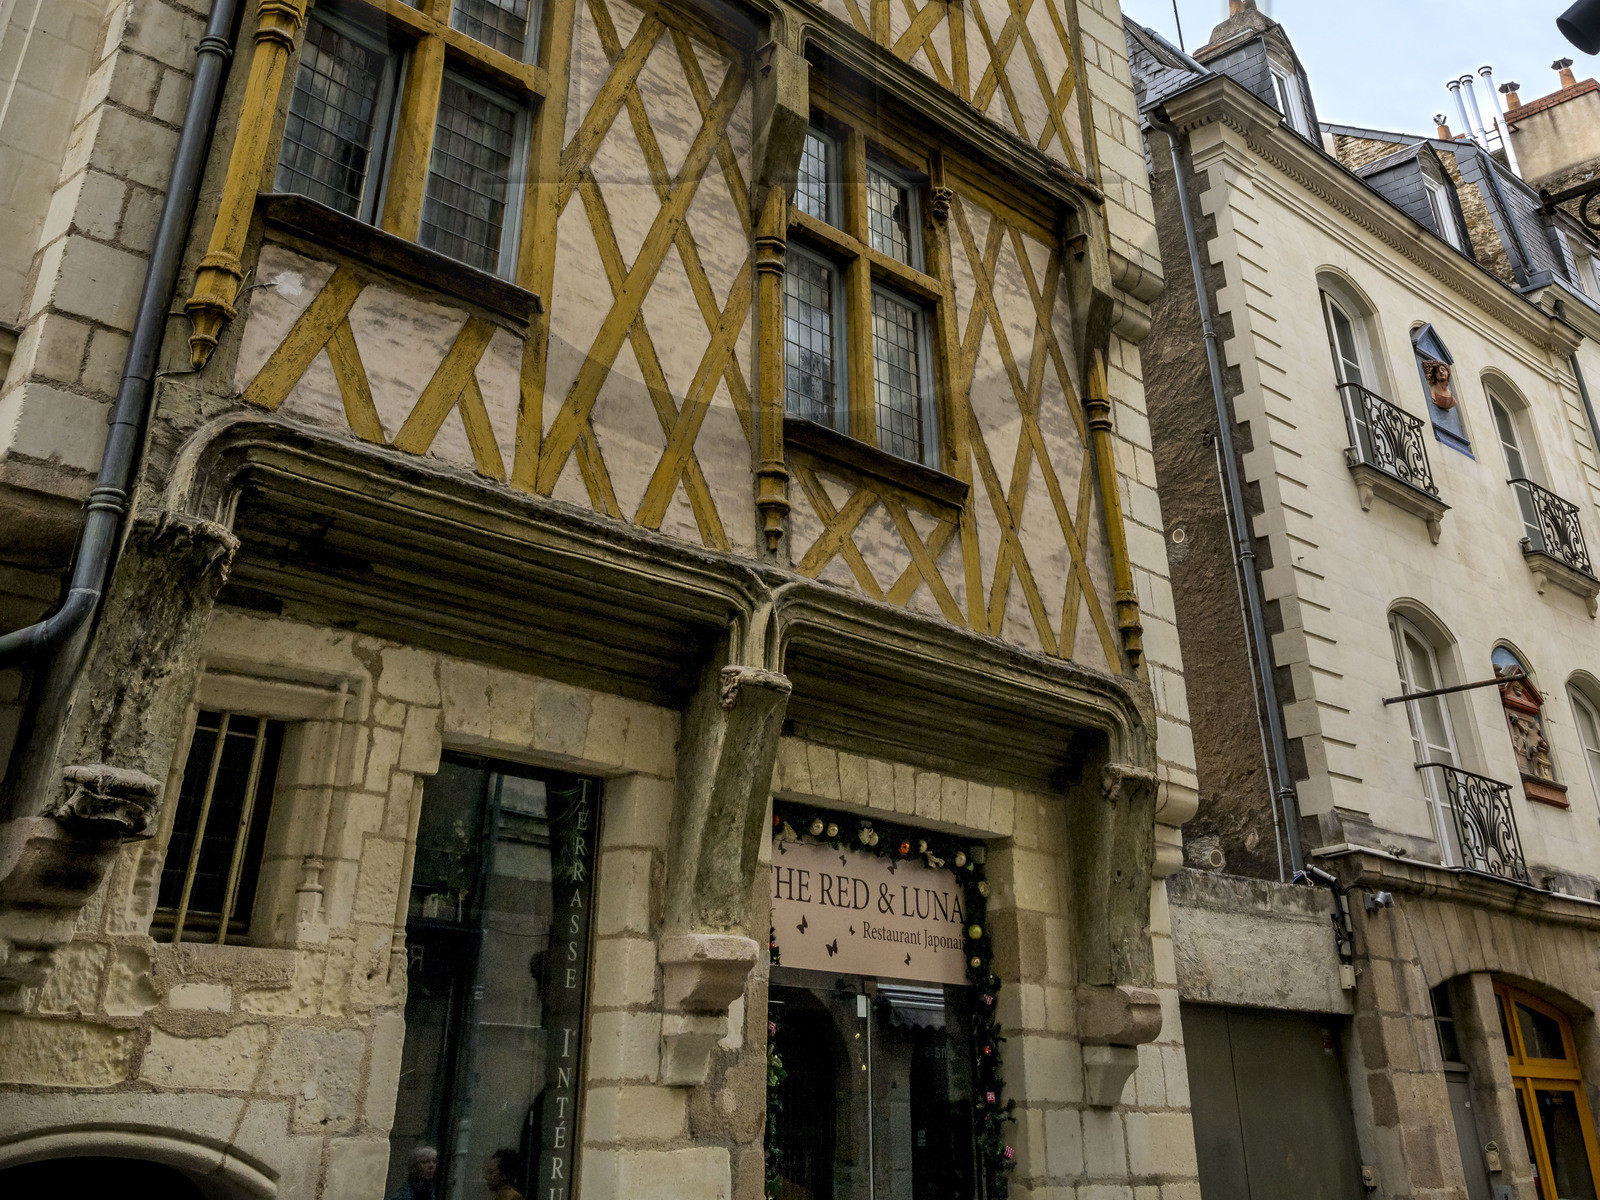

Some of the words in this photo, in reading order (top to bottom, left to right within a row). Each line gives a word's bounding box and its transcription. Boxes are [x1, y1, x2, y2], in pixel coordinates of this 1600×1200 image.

[565, 778, 592, 989] TERRASSE
[771, 865, 811, 903] HE
[819, 872, 869, 909] RED
[878, 883, 895, 915] &
[901, 885, 965, 924] LUNA
[863, 921, 921, 946] Restaurant
